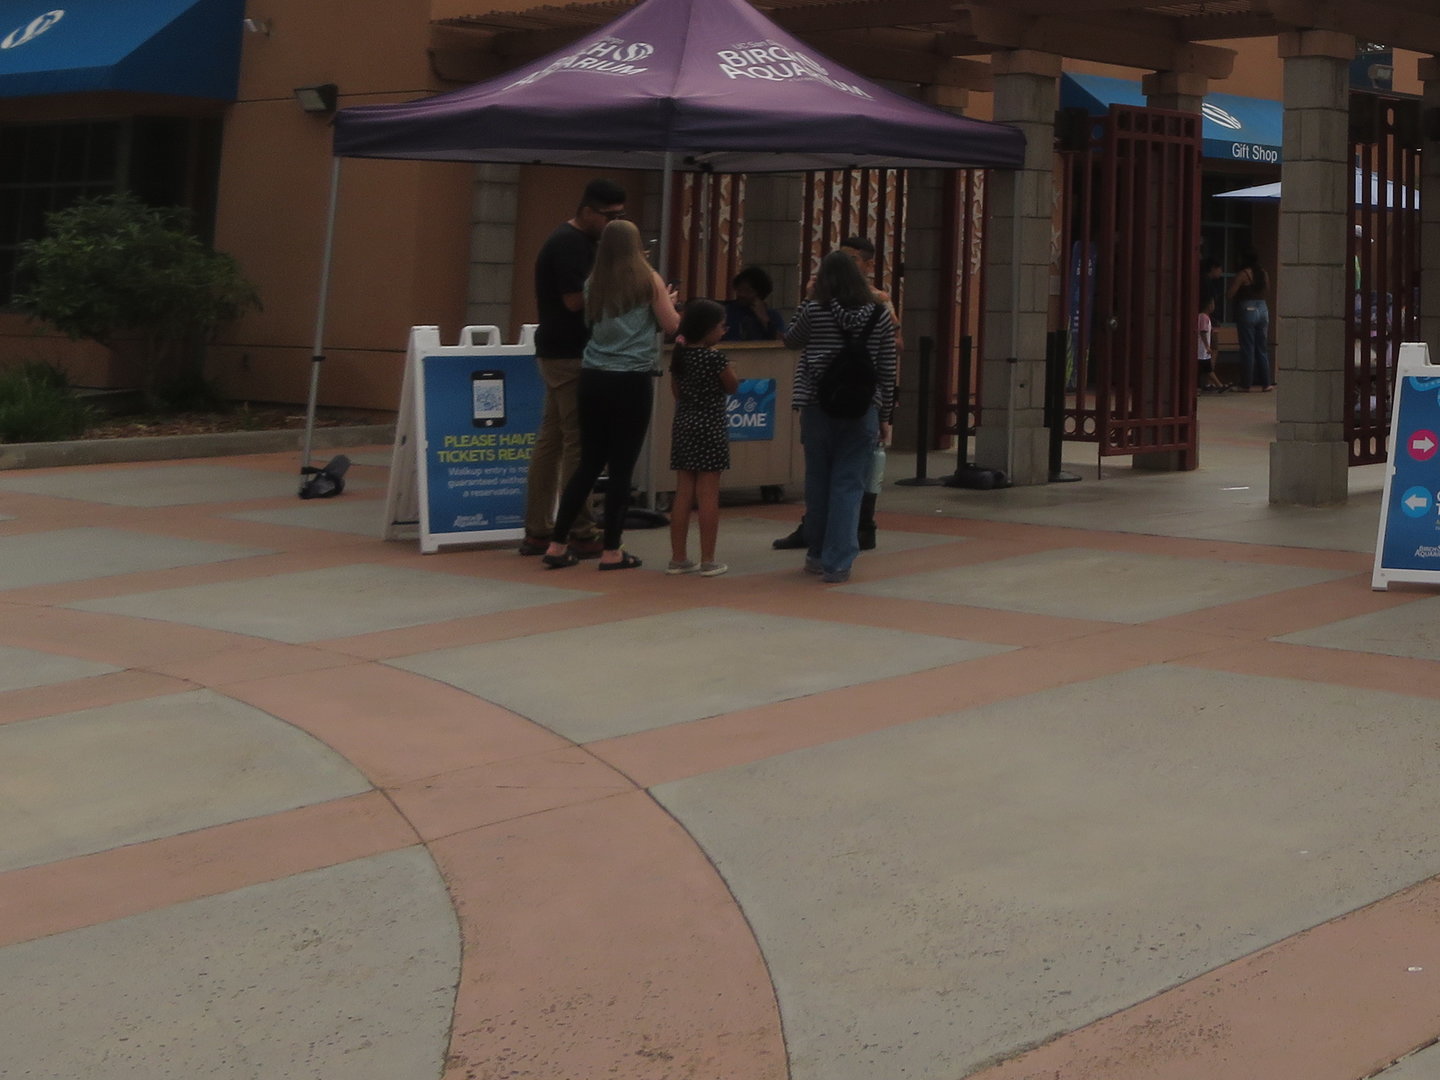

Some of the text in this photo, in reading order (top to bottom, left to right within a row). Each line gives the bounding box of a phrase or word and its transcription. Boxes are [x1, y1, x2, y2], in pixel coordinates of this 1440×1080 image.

[1232, 142, 1278, 164] Gift Shop
[444, 432, 537, 448] PLEASE HAVE
[436, 447, 536, 463] TICKETS READ
